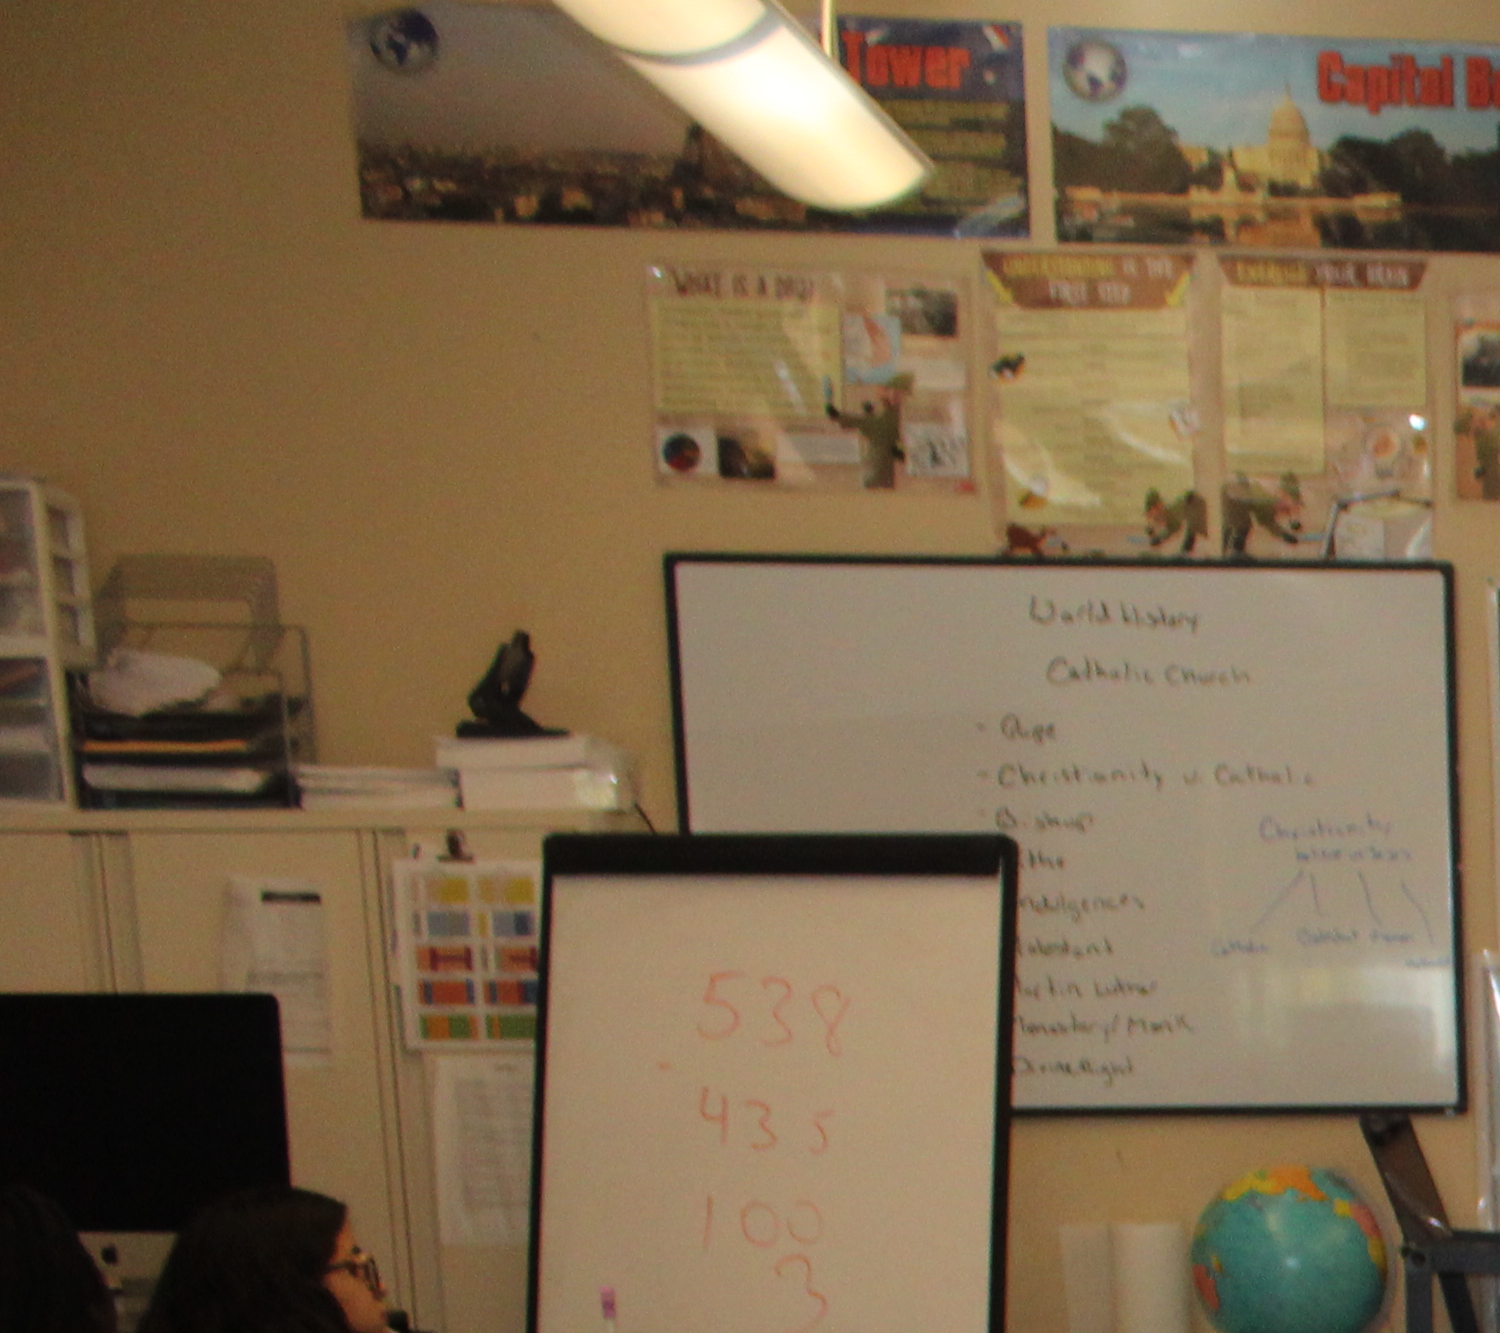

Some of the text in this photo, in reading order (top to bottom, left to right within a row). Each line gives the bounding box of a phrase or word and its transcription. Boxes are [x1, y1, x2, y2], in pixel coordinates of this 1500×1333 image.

[840, 30, 972, 90] Tower
[1317, 50, 1454, 115] Capital
[1029, 595, 1110, 626] World
[1047, 656, 1252, 686] Catholic Church
[997, 760, 1318, 791] Christianity Catholic
[1019, 893, 1145, 923] ndulgences
[1017, 976, 1082, 999] artin
[697, 970, 853, 1058] 538
[700, 1086, 836, 1155] 435
